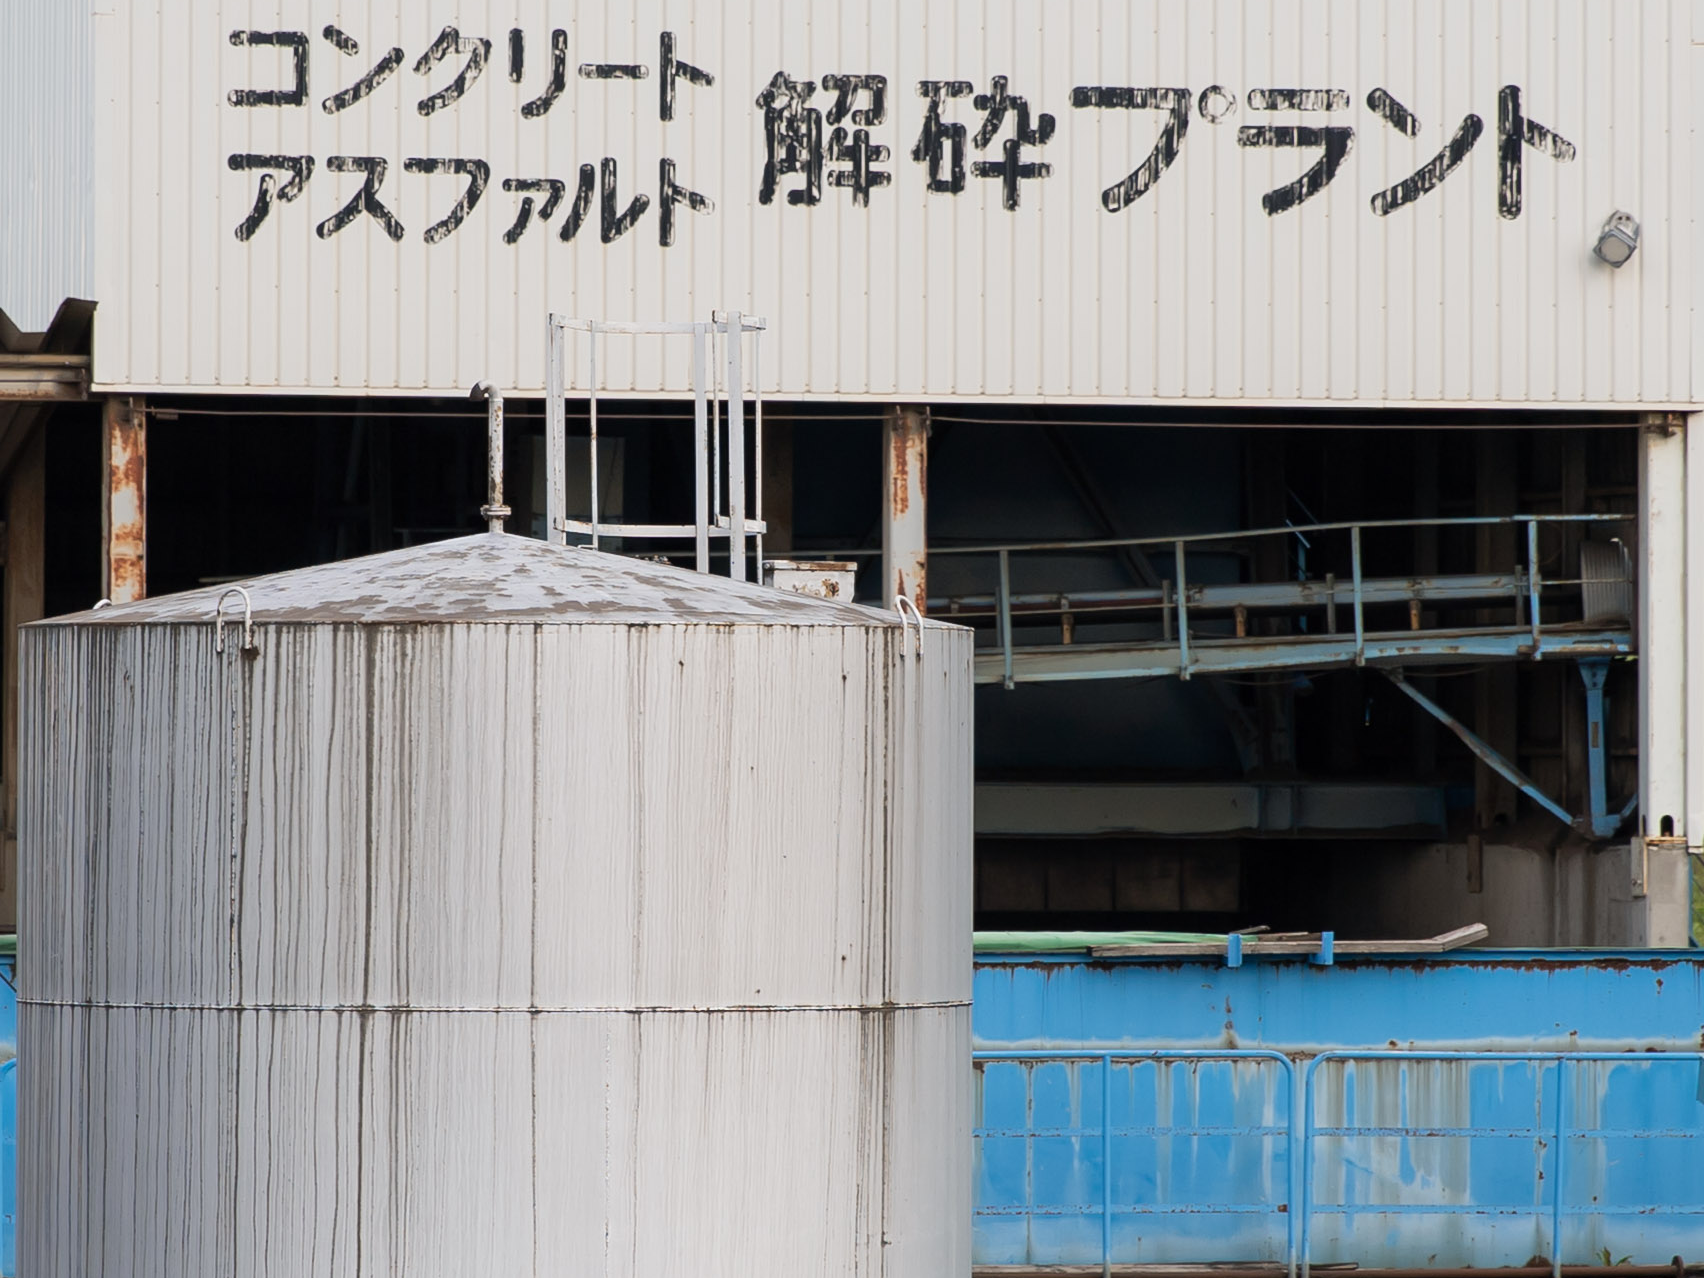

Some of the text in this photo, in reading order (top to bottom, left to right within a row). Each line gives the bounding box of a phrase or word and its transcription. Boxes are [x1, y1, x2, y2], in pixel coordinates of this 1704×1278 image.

[226, 25, 715, 121] コンクリート
[753, 70, 1578, 221] 解砕プラント
[226, 152, 715, 249] アスファルト
